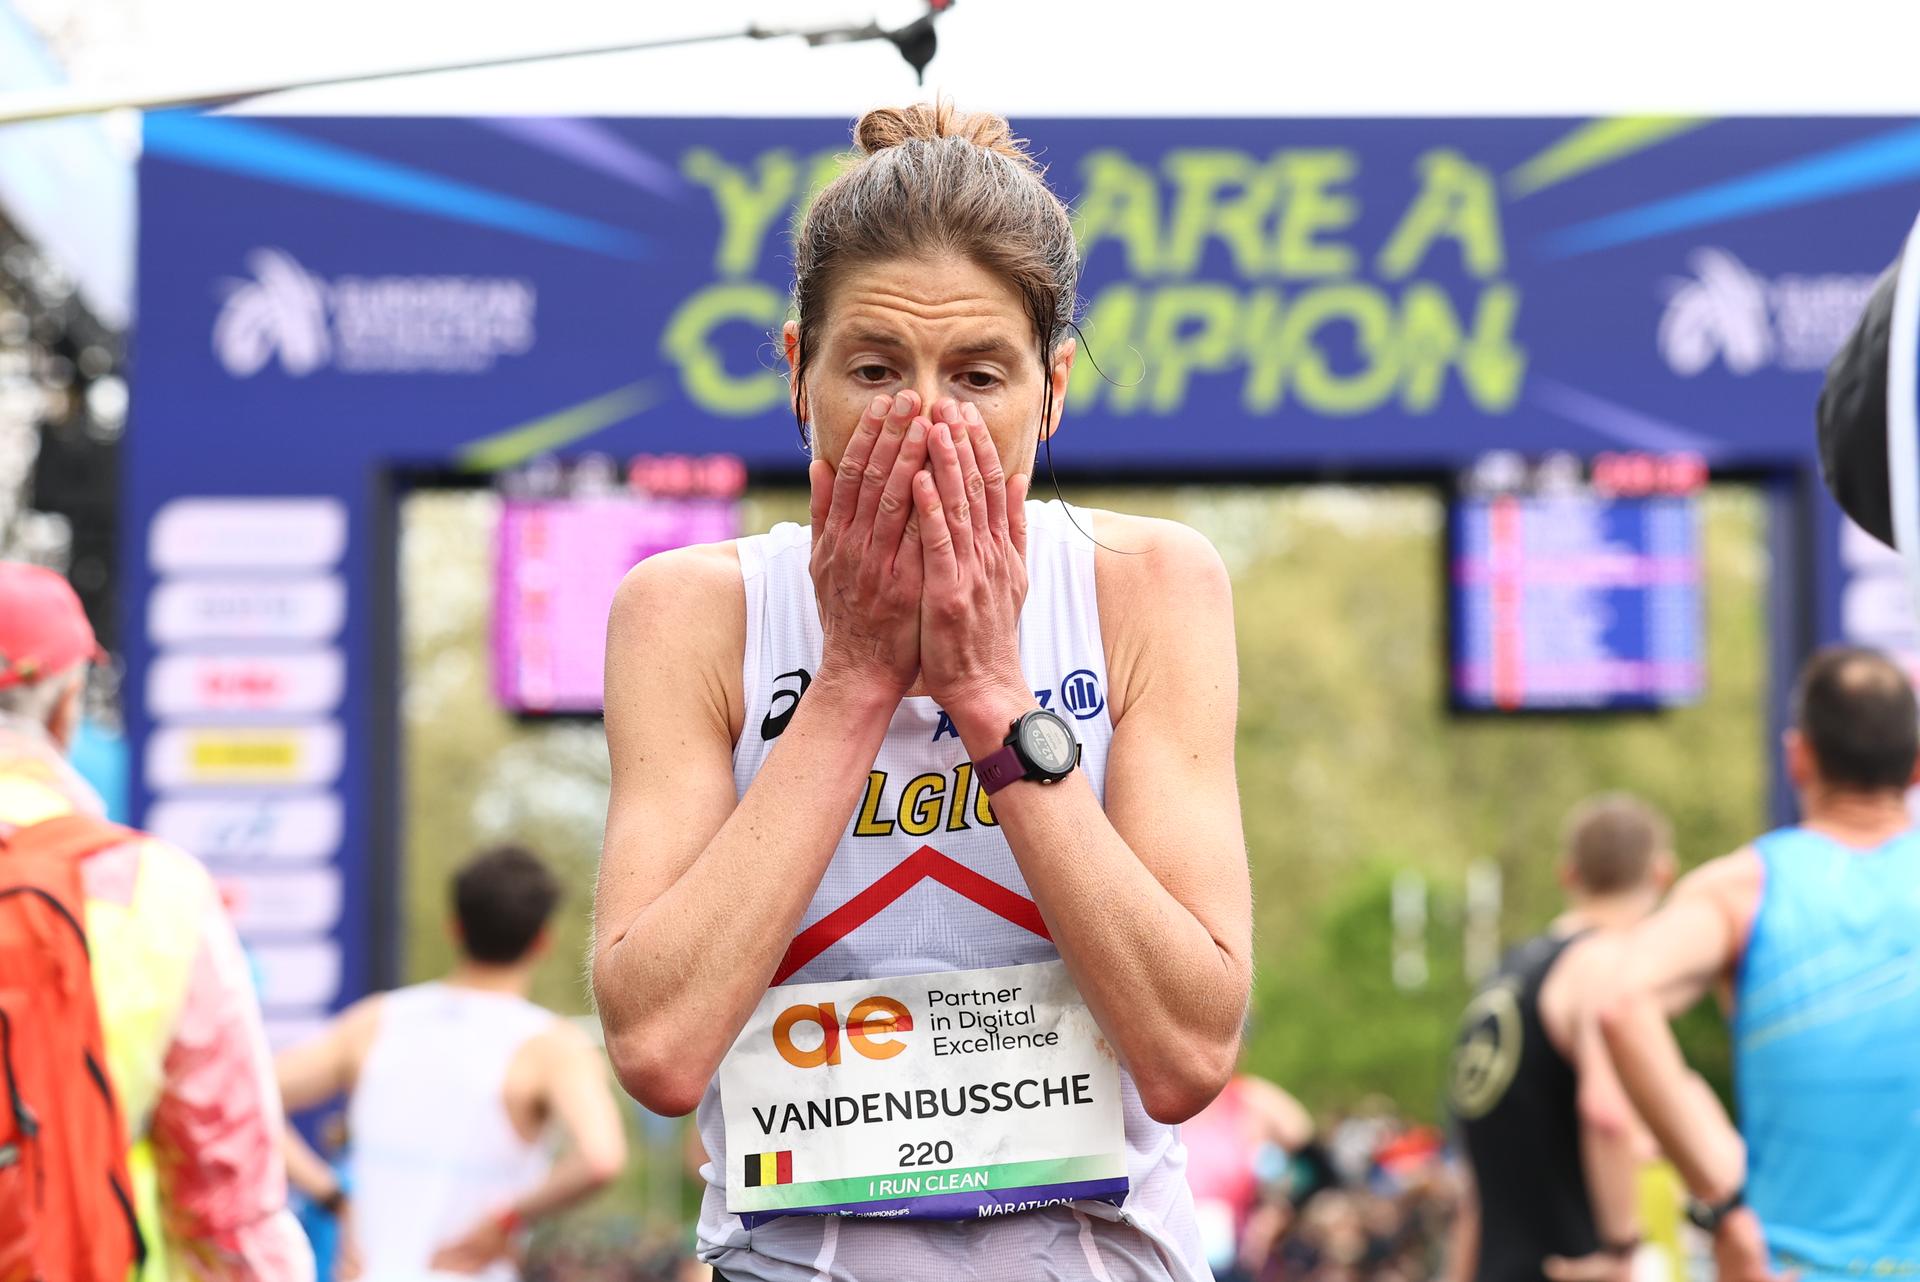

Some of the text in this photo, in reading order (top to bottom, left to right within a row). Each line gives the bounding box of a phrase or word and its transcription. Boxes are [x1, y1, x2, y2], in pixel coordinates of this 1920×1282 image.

[1074, 148, 1356, 278] ARE
[1377, 148, 1504, 278] A
[662, 283, 1523, 416] CMPION
[928, 985, 1022, 1008] Partner
[929, 1005, 1037, 1035] in Digital
[933, 1031, 1059, 1057] Excellence
[751, 1073, 1094, 1135] VANDENBUSSCHE
[898, 1140, 954, 1167] 220
[868, 1170, 989, 1197] I RUN CLEAN
